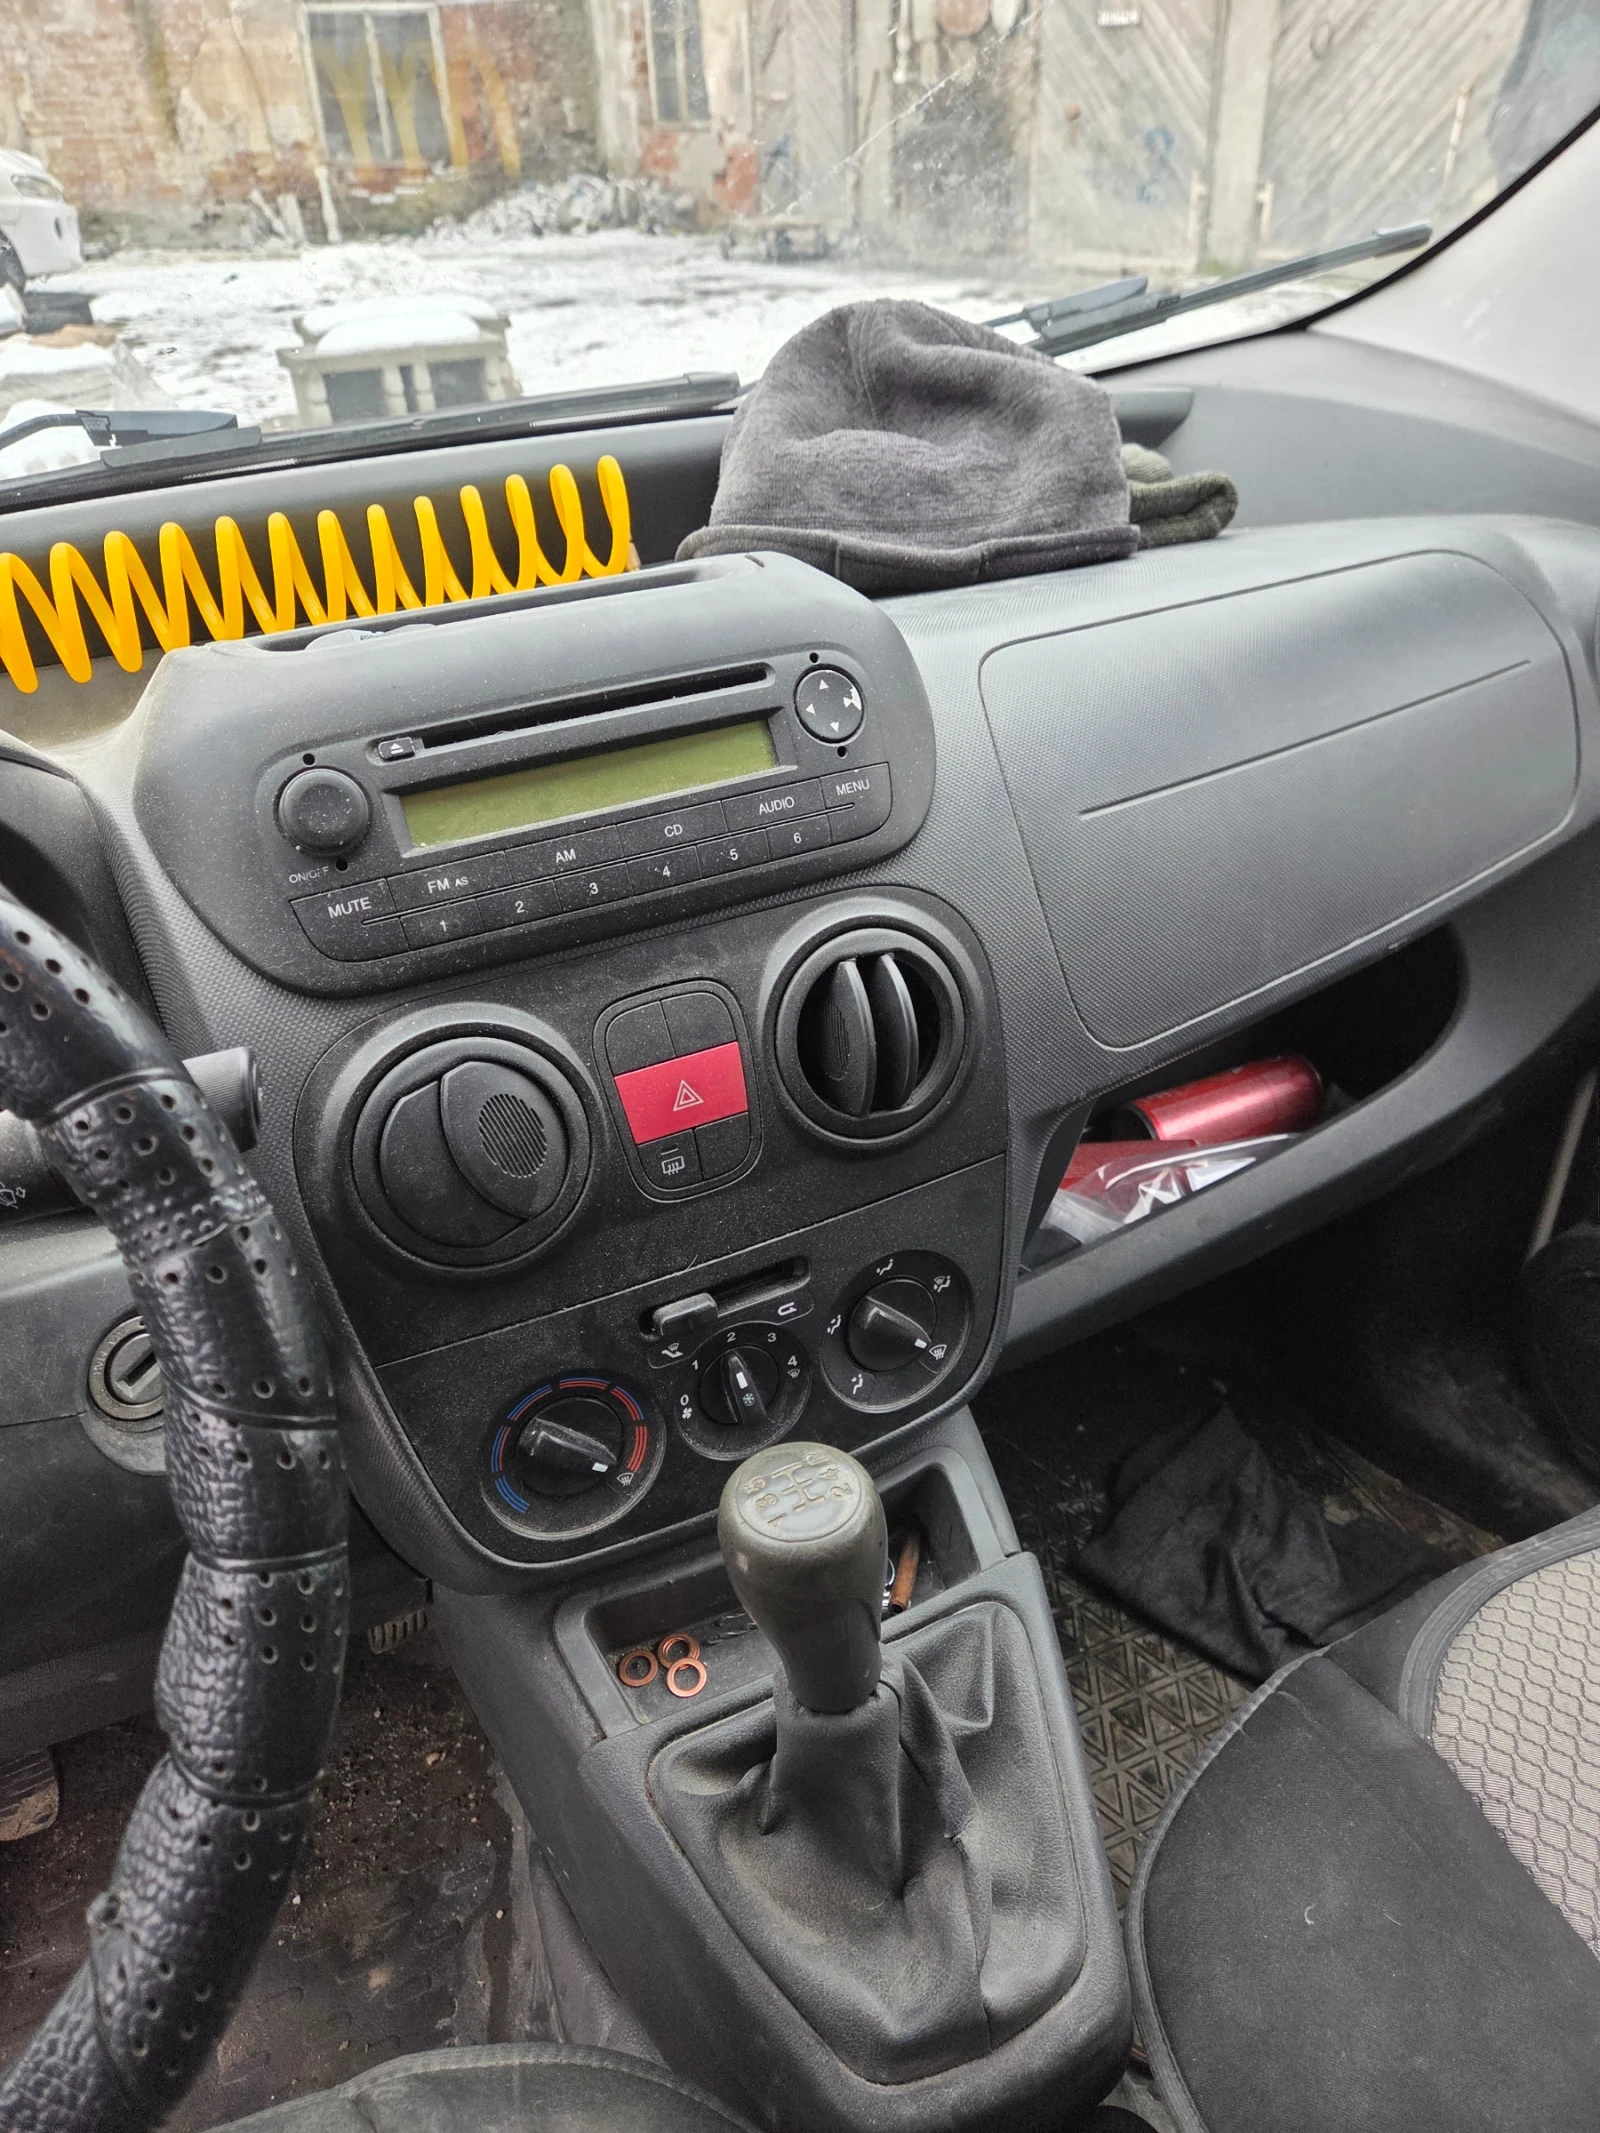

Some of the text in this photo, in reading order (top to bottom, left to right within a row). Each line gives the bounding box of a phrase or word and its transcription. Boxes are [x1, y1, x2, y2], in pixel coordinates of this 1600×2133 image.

[836, 778, 871, 796] MENU
[758, 796, 796, 815] AUDIO
[664, 823, 684, 838] CD
[793, 831, 803, 844] 6
[555, 848, 577, 863] AM
[729, 848, 740, 862] 5
[662, 865, 672, 878] 4
[427, 876, 470, 894] FM AS
[589, 882, 599, 895] 3
[328, 897, 373, 918] MUTE
[515, 901, 526, 914] 2
[439, 919, 449, 932] 1
[726, 1332, 737, 1342] 2
[767, 1332, 778, 1343] 3
[691, 1360, 699, 1370] 1
[787, 1355, 799, 1366] 4
[829, 1482, 853, 1498] 2
